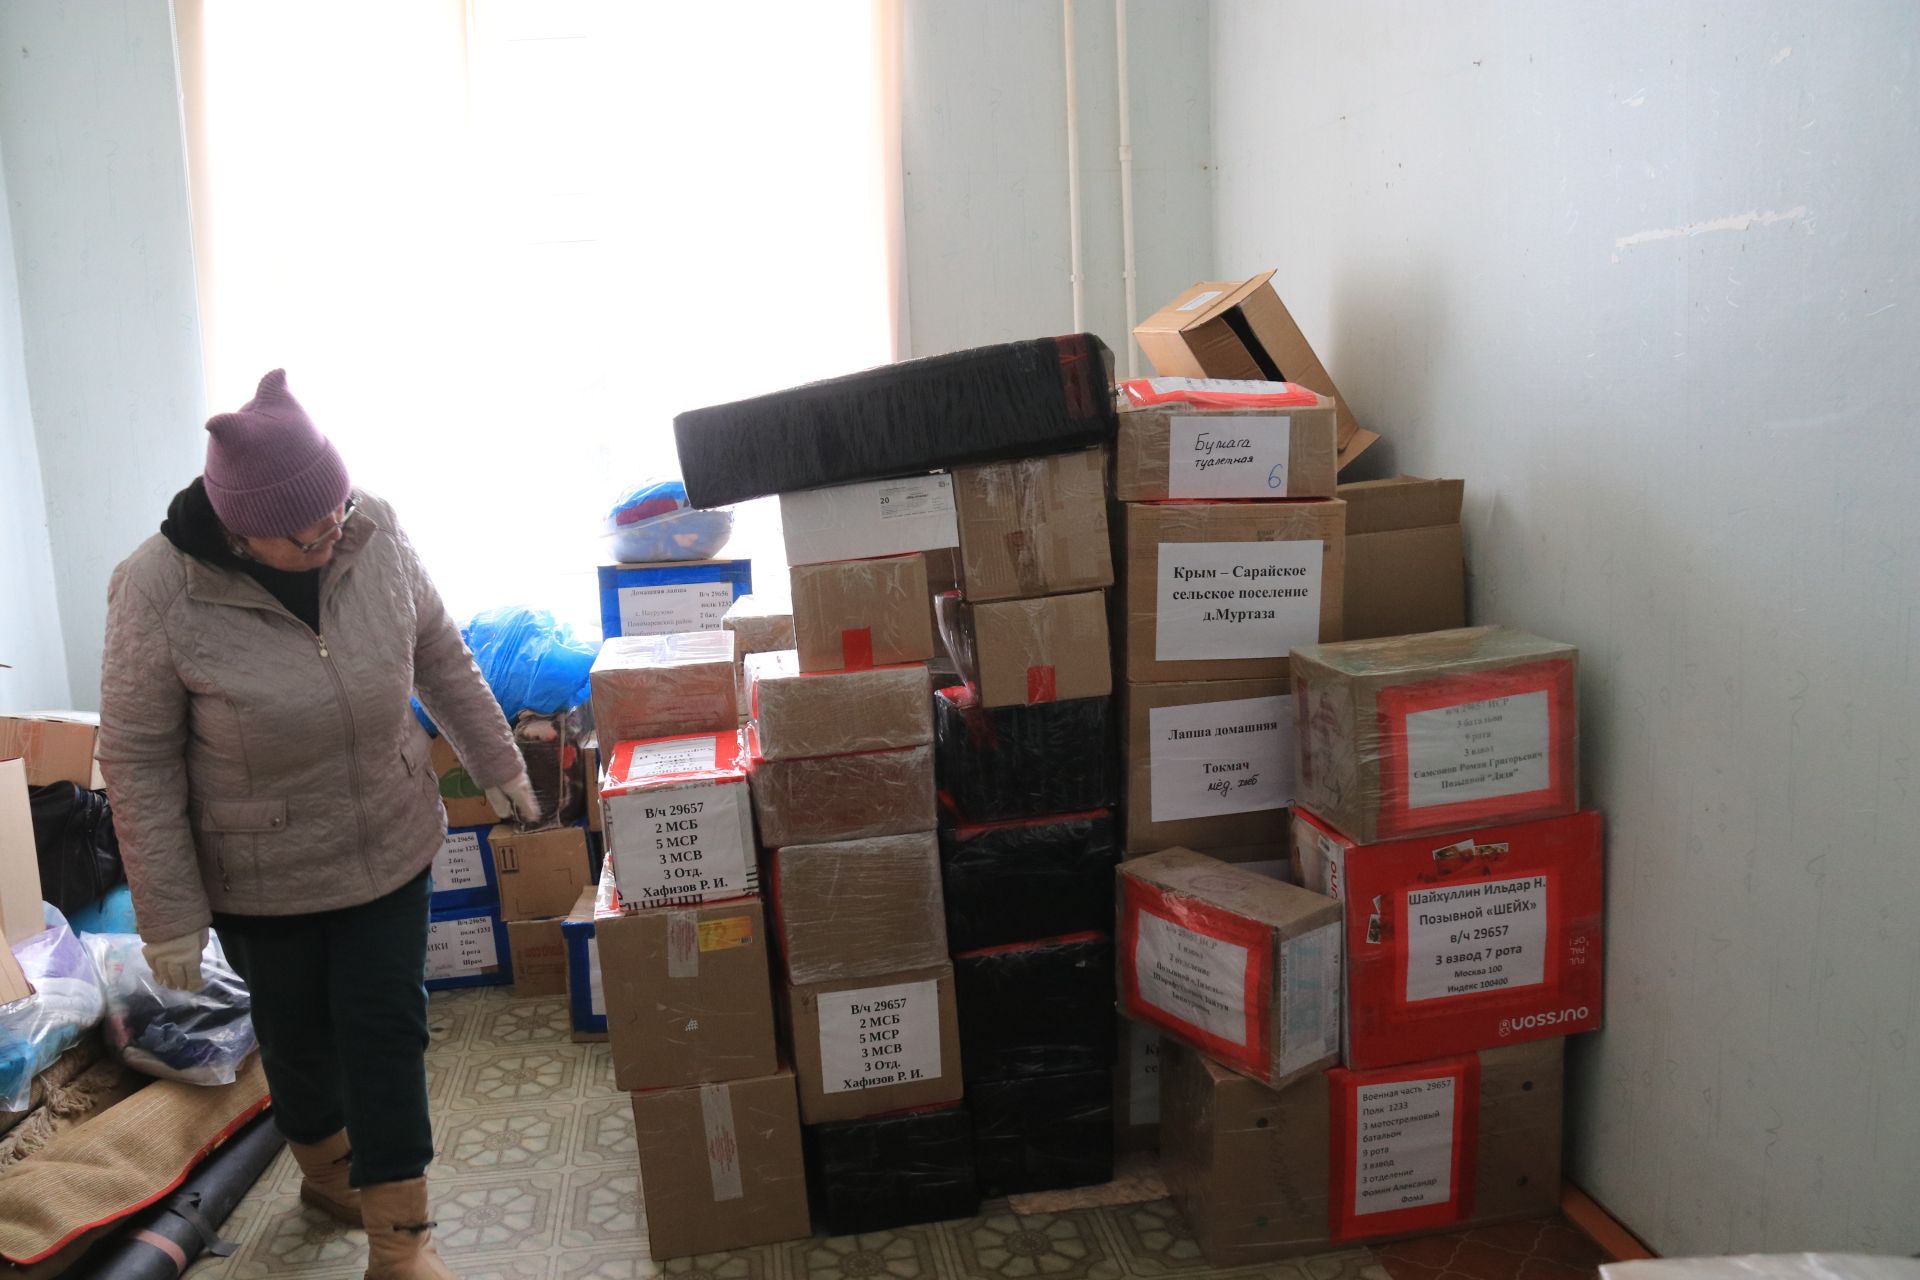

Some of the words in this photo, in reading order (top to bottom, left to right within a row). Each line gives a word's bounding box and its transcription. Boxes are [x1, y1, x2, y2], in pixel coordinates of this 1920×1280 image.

[1194, 432, 1252, 455] Бумага
[1194, 455, 1254, 471] туалетная
[1268, 463, 1283, 489] 6
[1173, 566, 1216, 581] Крым
[1232, 565, 1307, 581] Сарайское
[1172, 588, 1235, 600] сельское
[1238, 587, 1309, 599] поселение
[1202, 608, 1275, 623] д.Муртаза
[1167, 728, 1212, 741] Лапша
[1214, 721, 1278, 737] домашняя
[1202, 760, 1250, 774] Токмач
[645, 807, 667, 819] В/ч
[669, 802, 704, 816] 29657
[655, 823, 663, 834] 2
[666, 819, 698, 833] МСБ
[656, 838, 663, 850] 5
[667, 835, 698, 848] МСР
[659, 854, 667, 865] 3
[670, 849, 703, 864] МСВ
[664, 869, 671, 880] 3
[674, 867, 703, 879] Отд.
[643, 883, 697, 898] Хафизов
[700, 880, 711, 890] Р.
[713, 877, 728, 888] И.
[1409, 888, 1481, 906] Шайхуллин
[1484, 880, 1531, 896] Ильдар
[1534, 877, 1546, 889] Н.
[1419, 907, 1483, 926] Позывной
[1486, 899, 1537, 916] «ШЕЙХ»
[1450, 930, 1470, 944] в/ч
[1474, 925, 1509, 940] 29657
[1435, 955, 1442, 966] 3
[1446, 951, 1482, 965] взвод
[1485, 948, 1493, 959] 7
[1495, 945, 1522, 959] рота
[1454, 968, 1486, 978] Москва
[1488, 965, 1503, 975] 100
[1447, 983, 1478, 994] Индекс
[851, 1004, 871, 1015] В/ч
[874, 998, 907, 1012] 29657
[860, 1018, 867, 1029] 2
[869, 1014, 900, 1027] МСБ
[1511, 1007, 1589, 1030] oursson
[860, 1033, 866, 1044] 5
[869, 1029, 900, 1042] МСР
[861, 1048, 869, 1058] 3
[872, 1044, 902, 1057] МСВ
[864, 1062, 872, 1072] 3
[875, 1060, 901, 1070] Отд.
[842, 1076, 894, 1089] Хафизов
[897, 1071, 907, 1081] Р.
[910, 1069, 924, 1079] И.
[1362, 1090, 1399, 1102] Военная
[1401, 1086, 1423, 1096] часть
[1426, 1080, 1452, 1091] 29657
[1363, 1107, 1385, 1116] Полк
[1388, 1101, 1409, 1112] 1233
[1363, 1122, 1368, 1130] 3
[1370, 1110, 1440, 1129] мотострелковый
[1362, 1131, 1402, 1143] батальон
[1370, 1147, 1389, 1157] рота
[1369, 1159, 1395, 1169] взвод
[1362, 1176, 1368, 1184] 3
[1369, 1169, 1414, 1183] отделение
[1362, 1186, 1391, 1198] Фомин
[1393, 1178, 1438, 1192] Александр
[1401, 1194, 1424, 1203] Фома
